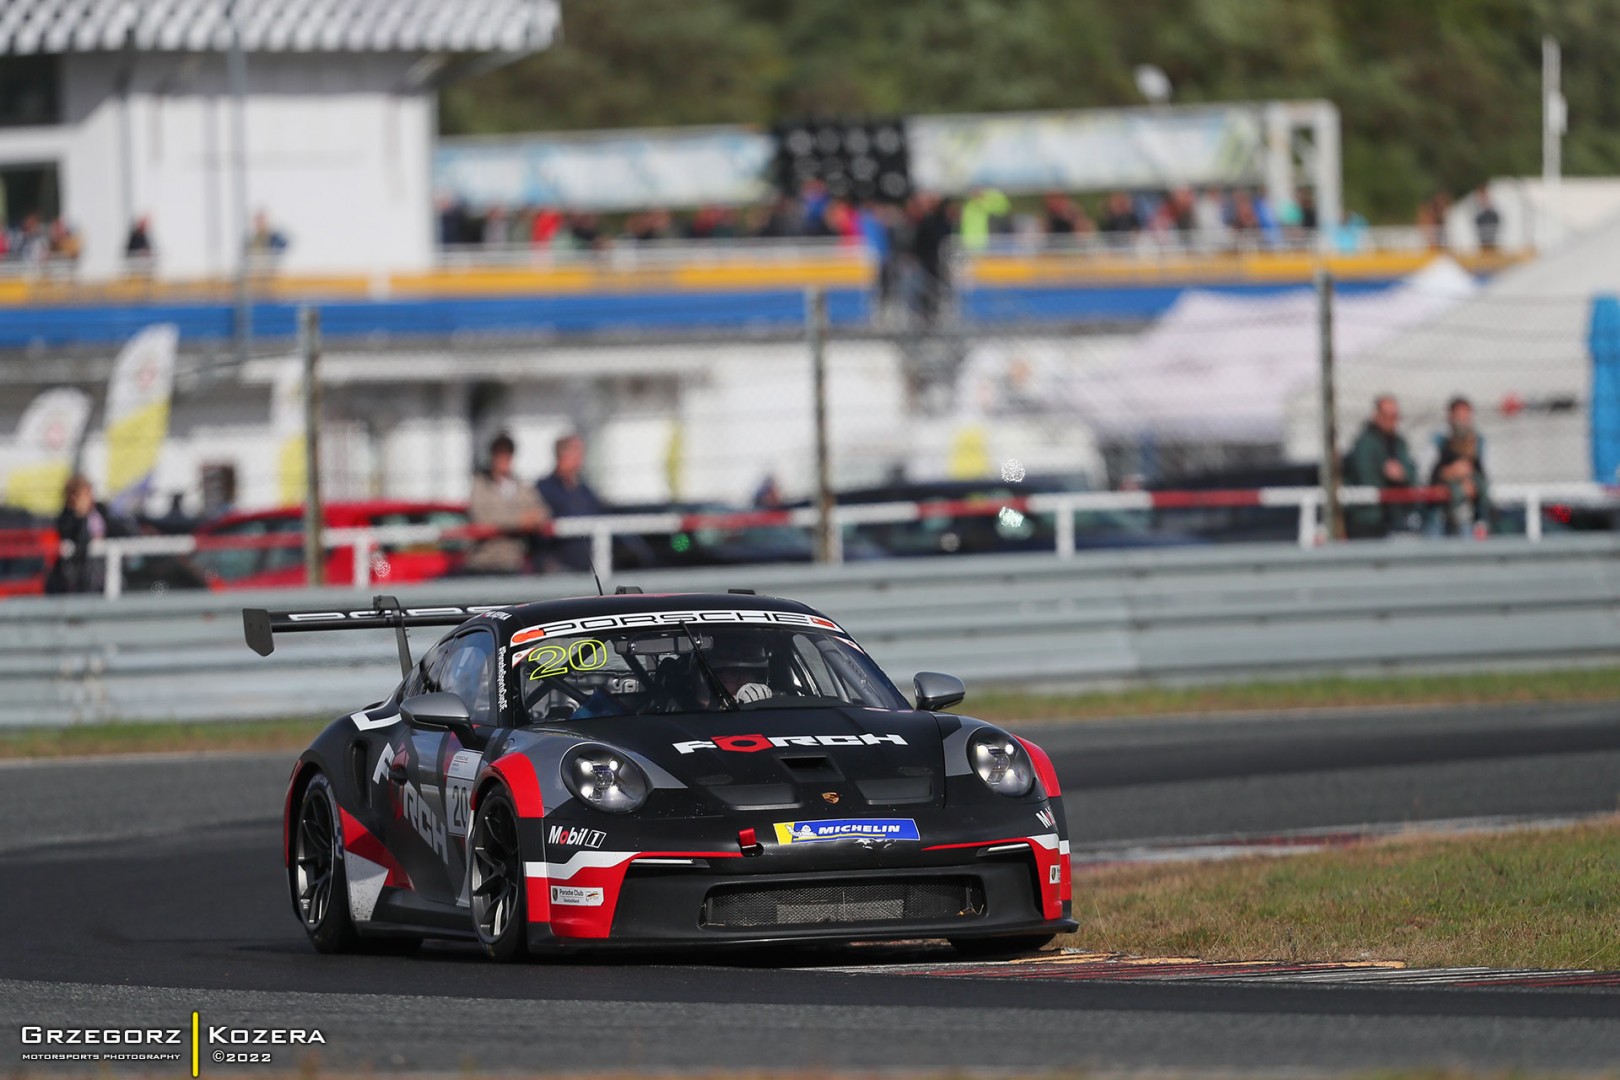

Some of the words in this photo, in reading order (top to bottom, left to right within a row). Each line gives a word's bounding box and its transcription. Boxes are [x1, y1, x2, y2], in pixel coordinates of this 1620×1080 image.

[542, 611, 808, 634] PORSCHE
[528, 639, 608, 681] 20
[452, 785, 468, 828] 20
[548, 825, 588, 846] Mobil
[818, 824, 901, 835] MICHELIN
[559, 888, 574, 896] Porsche
[574, 889, 584, 897] Club
